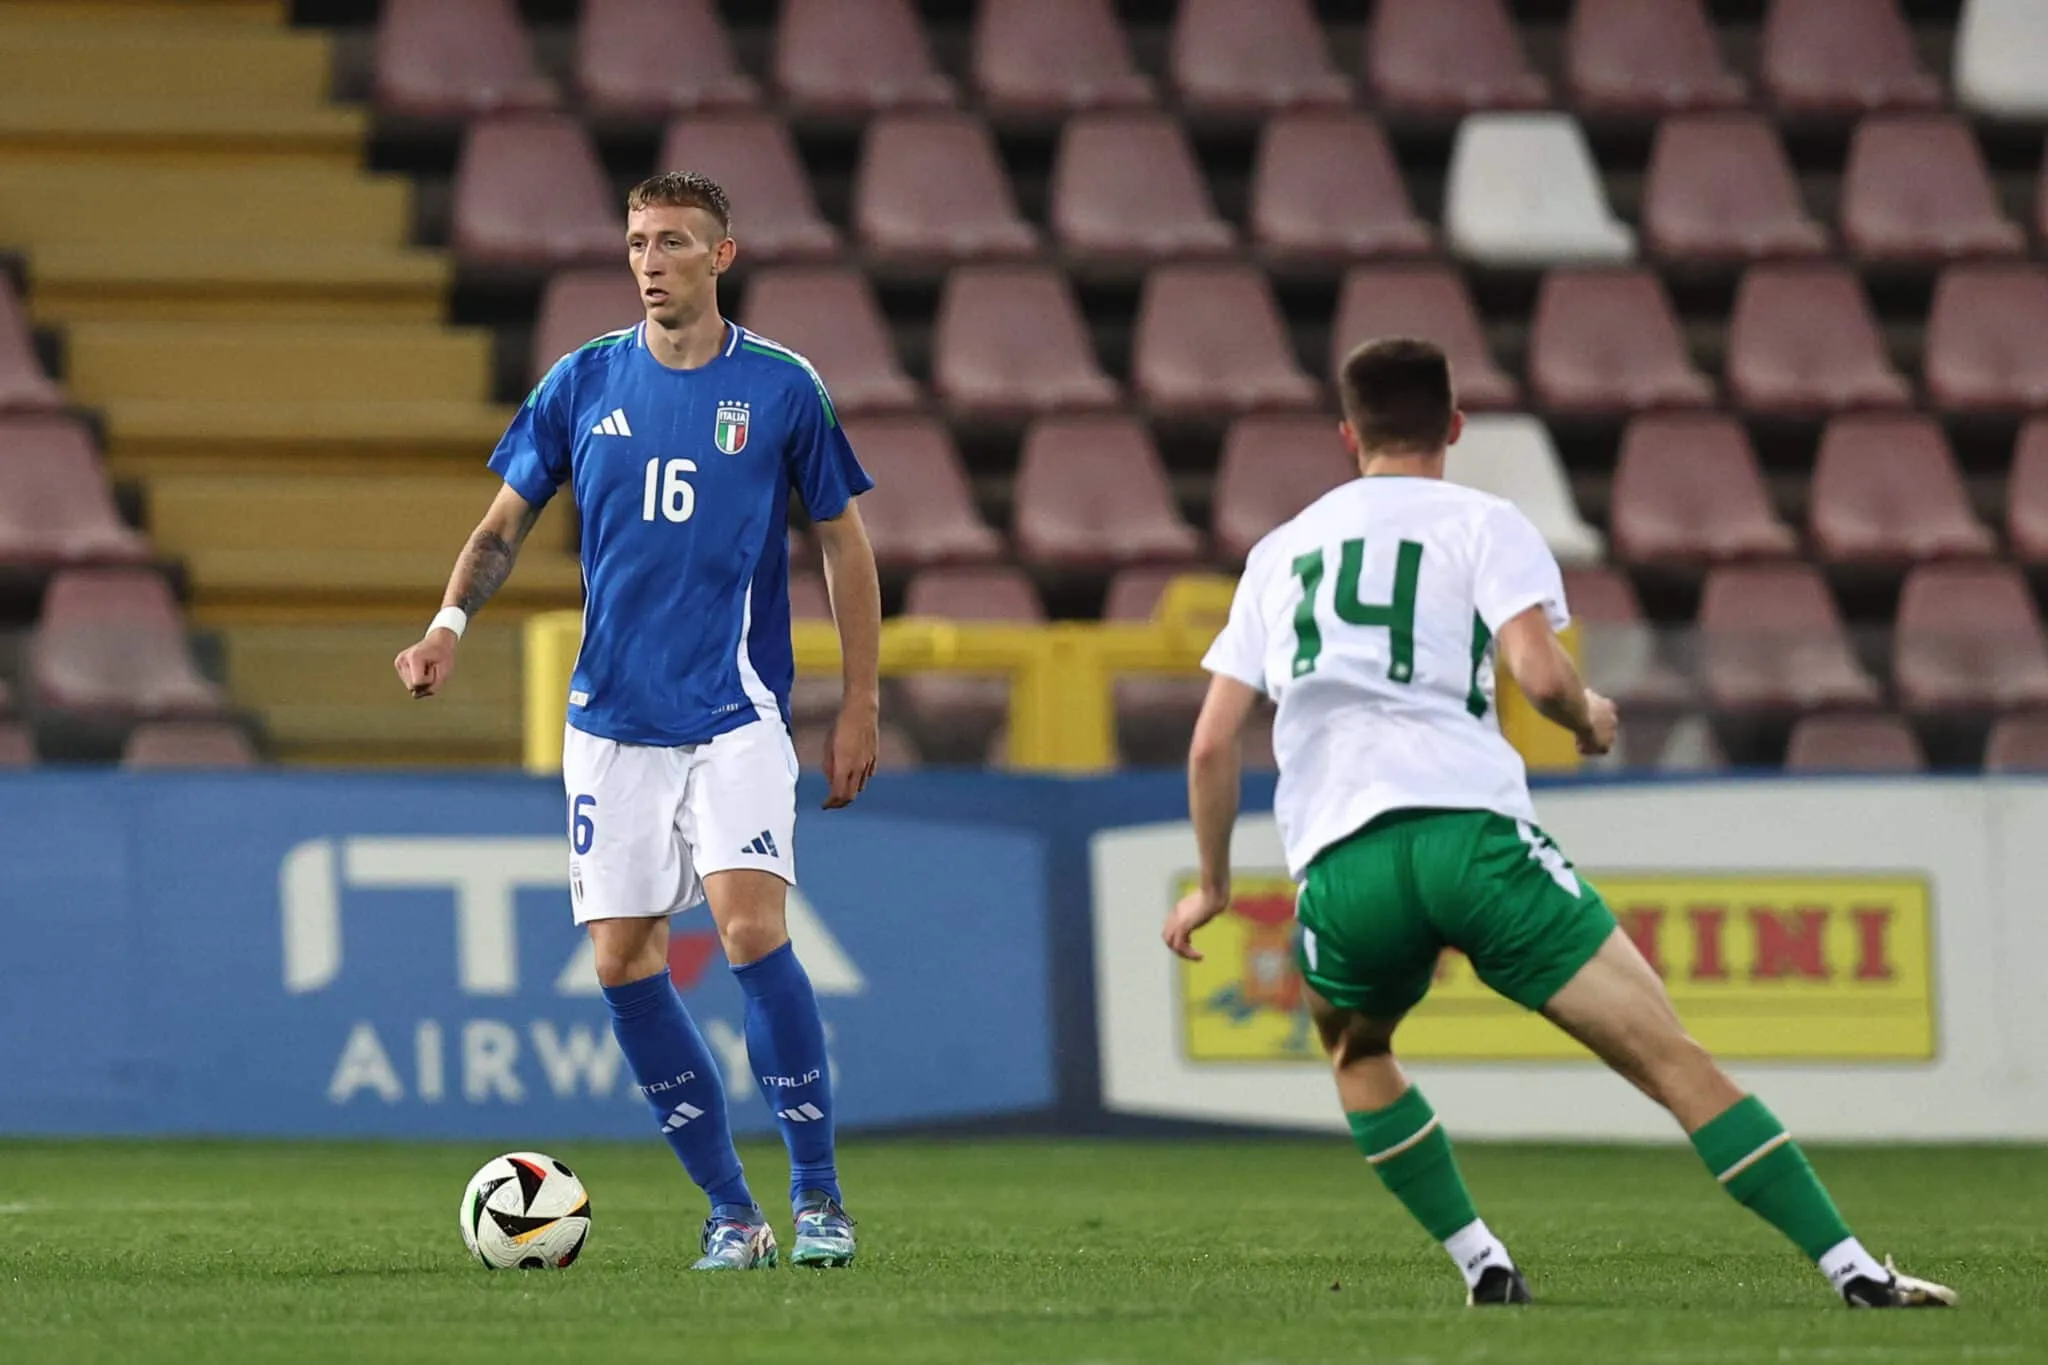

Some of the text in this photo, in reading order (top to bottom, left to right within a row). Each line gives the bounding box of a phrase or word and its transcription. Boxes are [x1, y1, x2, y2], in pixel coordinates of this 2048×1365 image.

[719, 411, 746, 421] ITALIA
[641, 457, 697, 523] 16
[1290, 538, 1424, 684] 14
[567, 793, 596, 855] 6
[328, 1018, 840, 1102] AIRWY
[638, 1070, 696, 1095] TALIA
[761, 1068, 821, 1088] ITALIA
